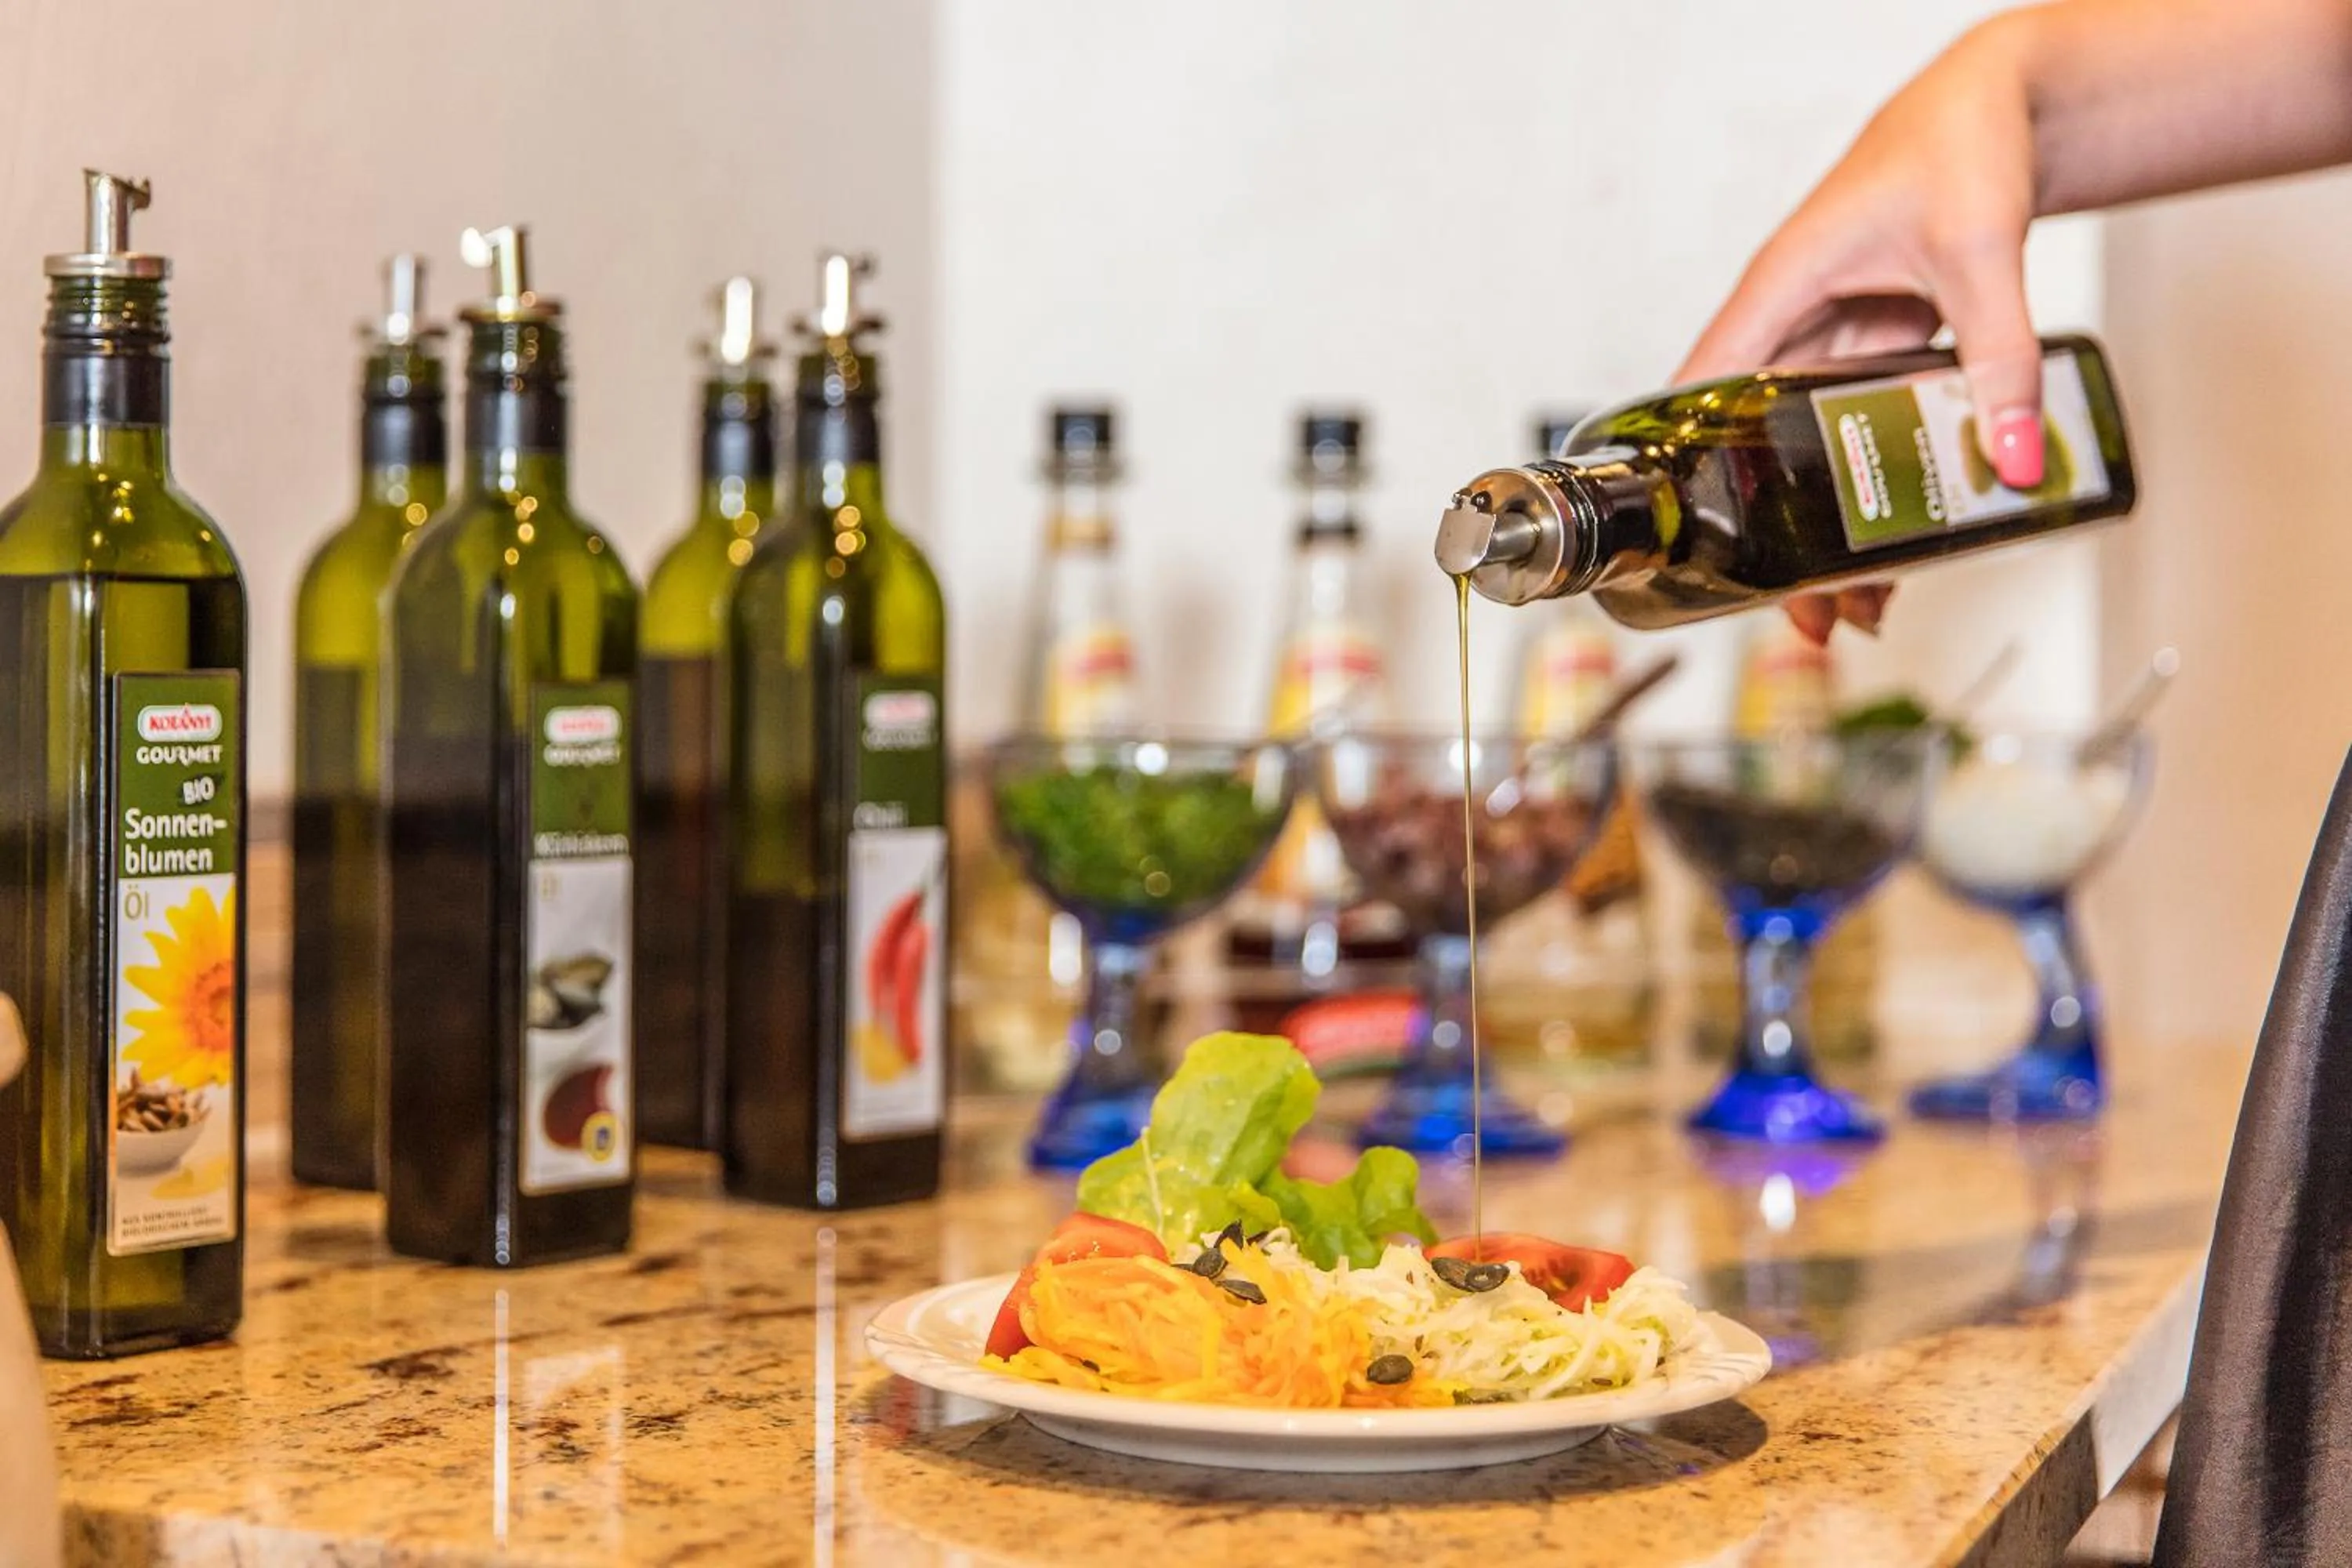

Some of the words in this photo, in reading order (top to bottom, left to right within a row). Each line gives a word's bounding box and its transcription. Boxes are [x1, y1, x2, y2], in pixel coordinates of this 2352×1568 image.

[136, 745, 223, 766] GOURMET
[183, 776, 215, 804] BIO
[125, 808, 227, 840] Sonnen-
[125, 844, 212, 874] blumen
[125, 884, 149, 921] Öl
